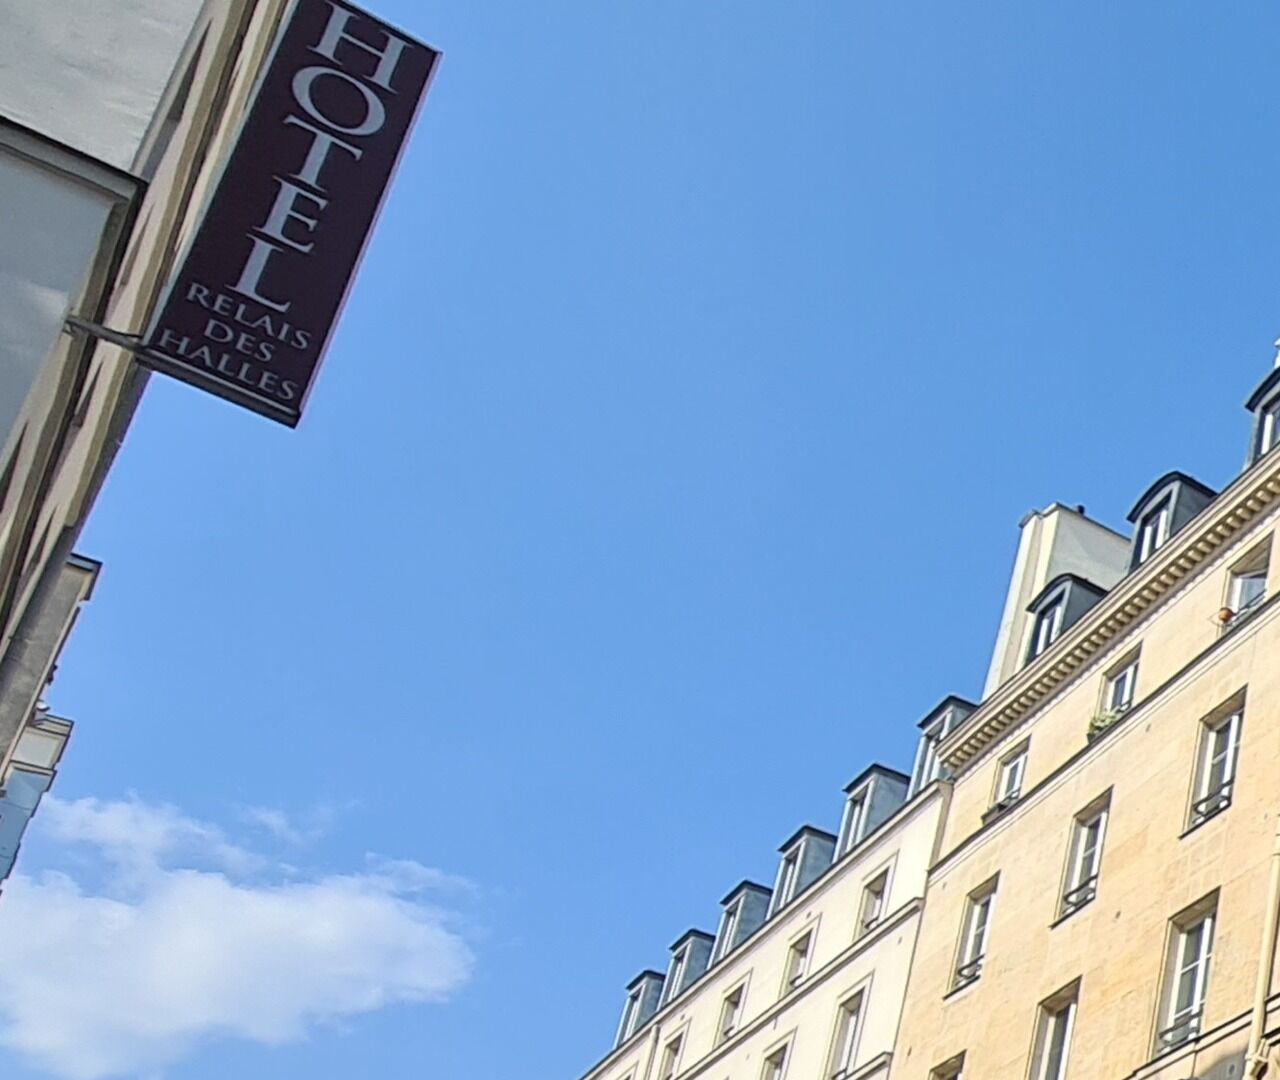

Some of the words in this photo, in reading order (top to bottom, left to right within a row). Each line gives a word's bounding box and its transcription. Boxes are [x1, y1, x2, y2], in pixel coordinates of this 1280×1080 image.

[225, 2, 413, 312] HOTEL
[186, 283, 312, 350] RELAIS
[203, 318, 276, 363] DES
[159, 328, 299, 401] HALLES
